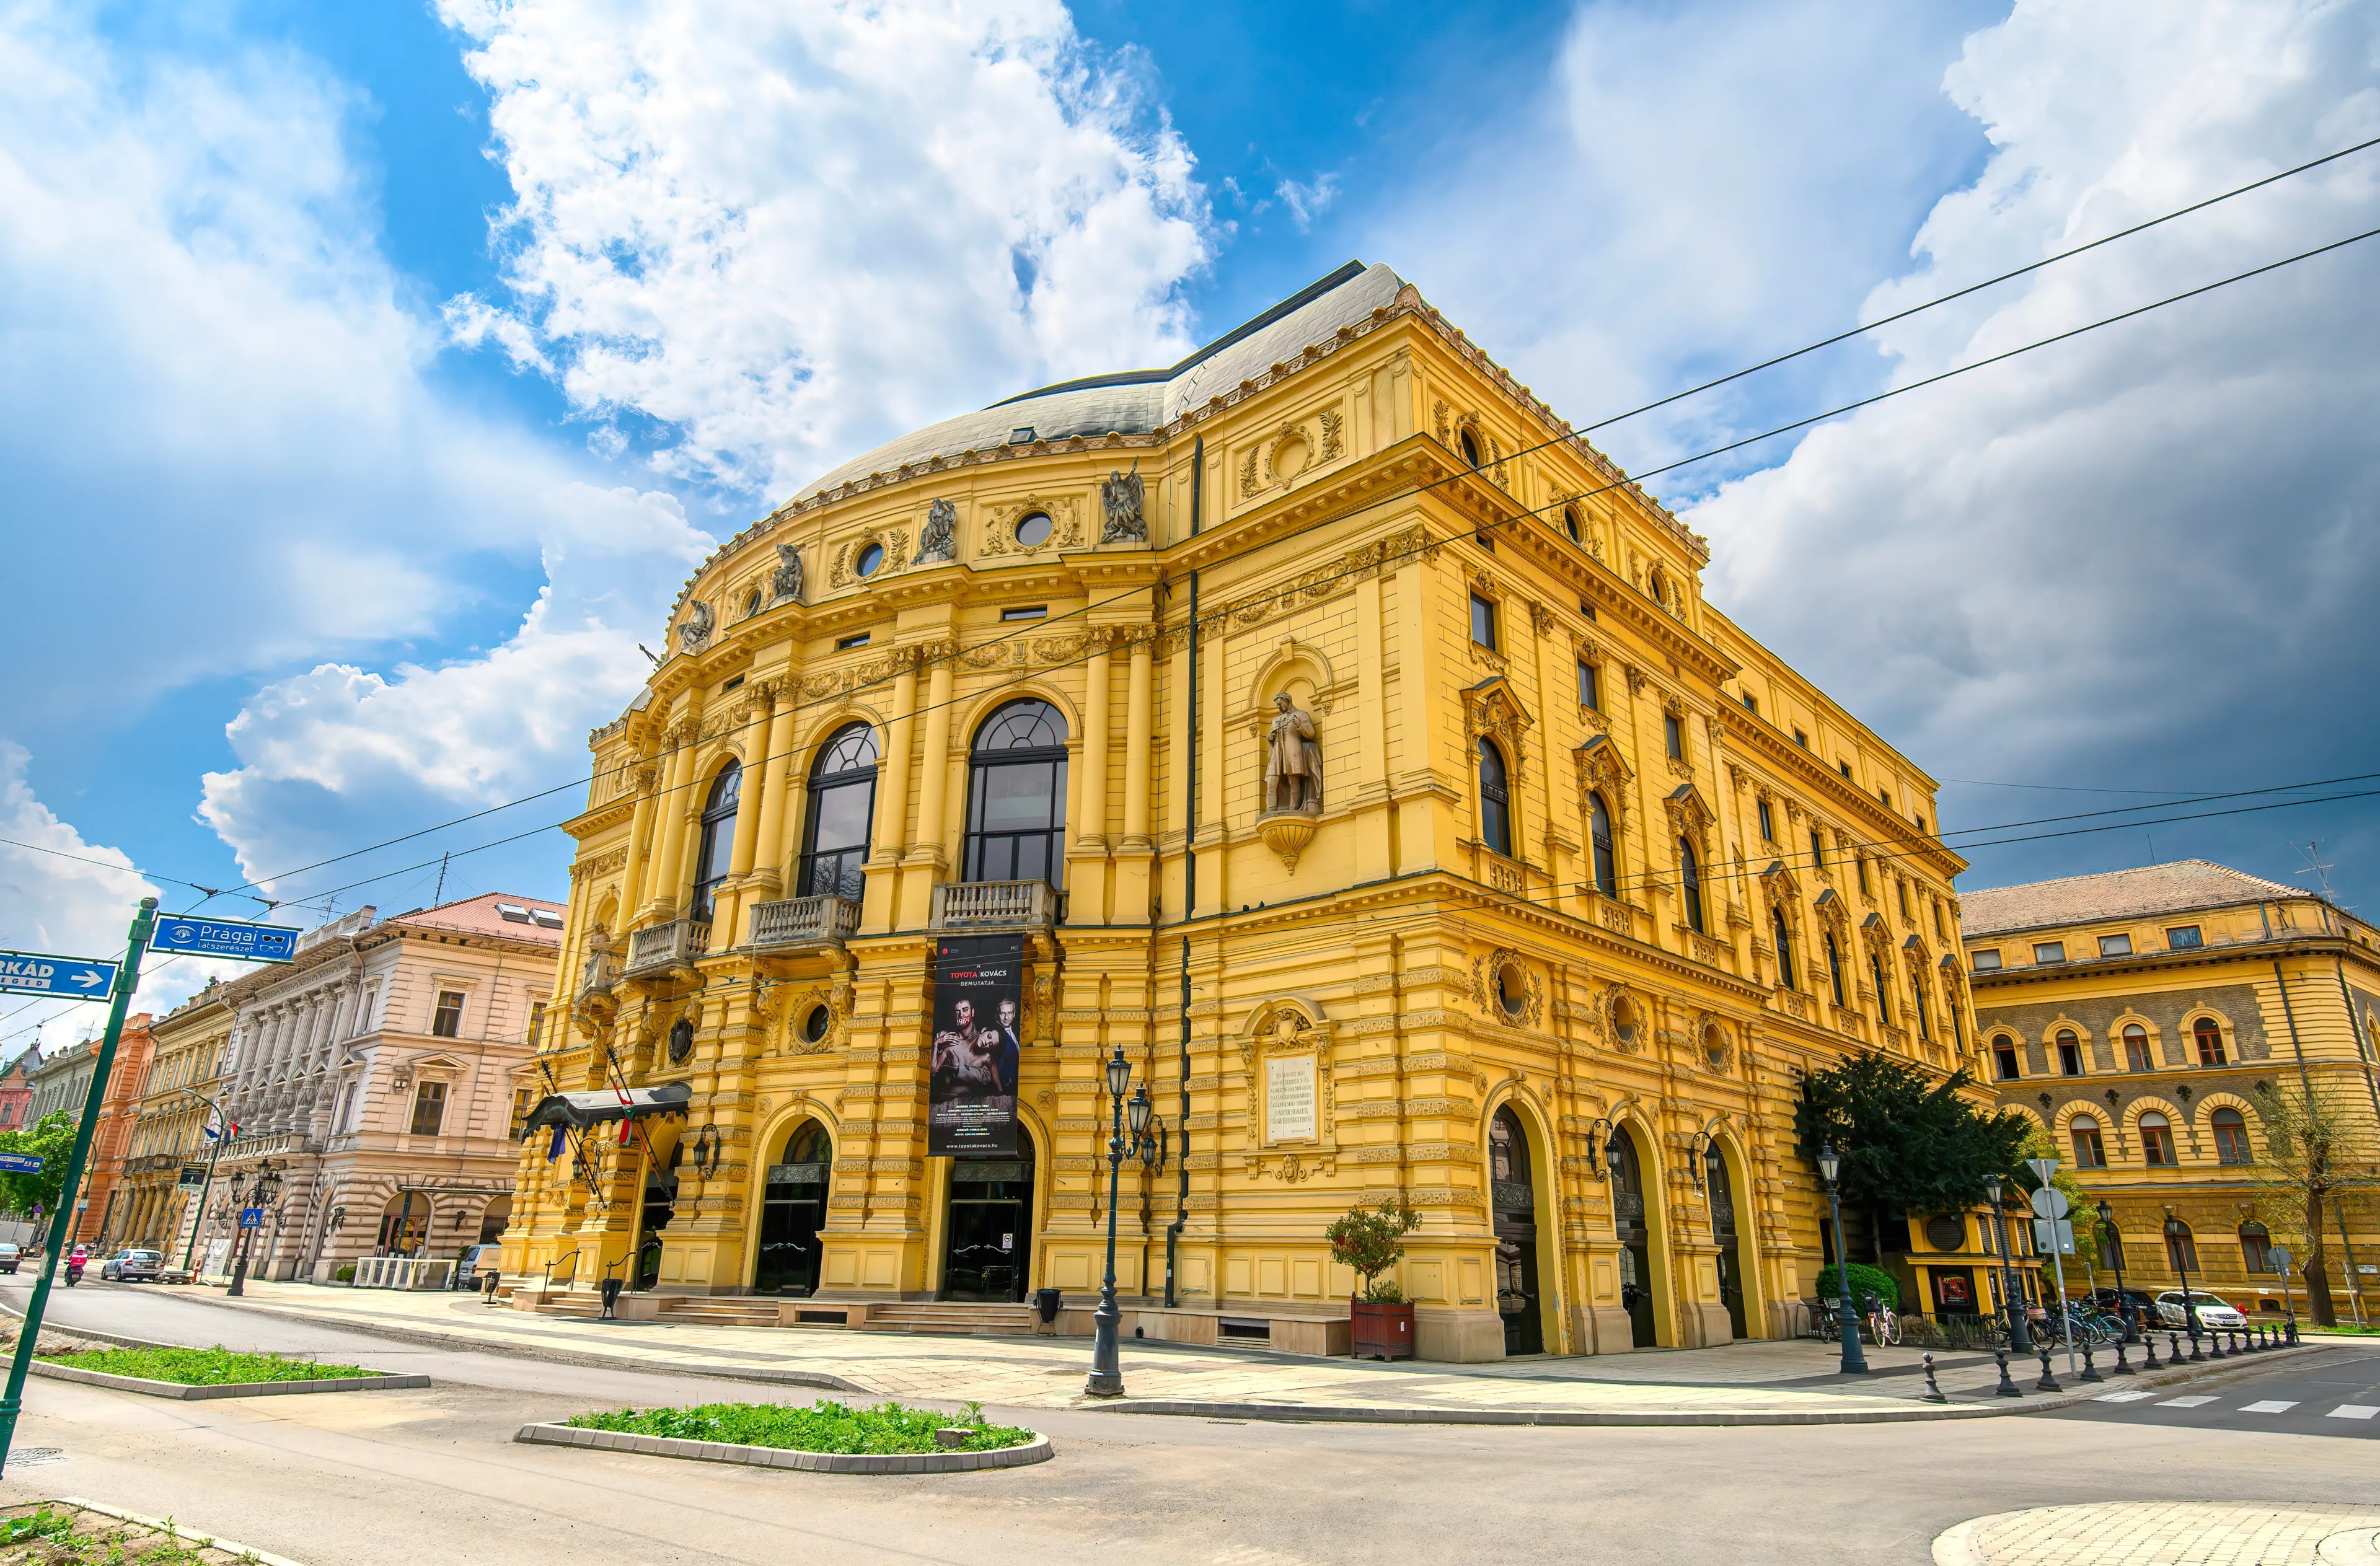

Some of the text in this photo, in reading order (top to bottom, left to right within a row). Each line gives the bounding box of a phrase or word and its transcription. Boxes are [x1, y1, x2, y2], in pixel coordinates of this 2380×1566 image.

[200, 925, 258, 943] Prágai
[198, 941, 253, 952] látszerészet
[980, 969, 1007, 977] KOVÁCS
[956, 1016, 970, 1026] 1984
